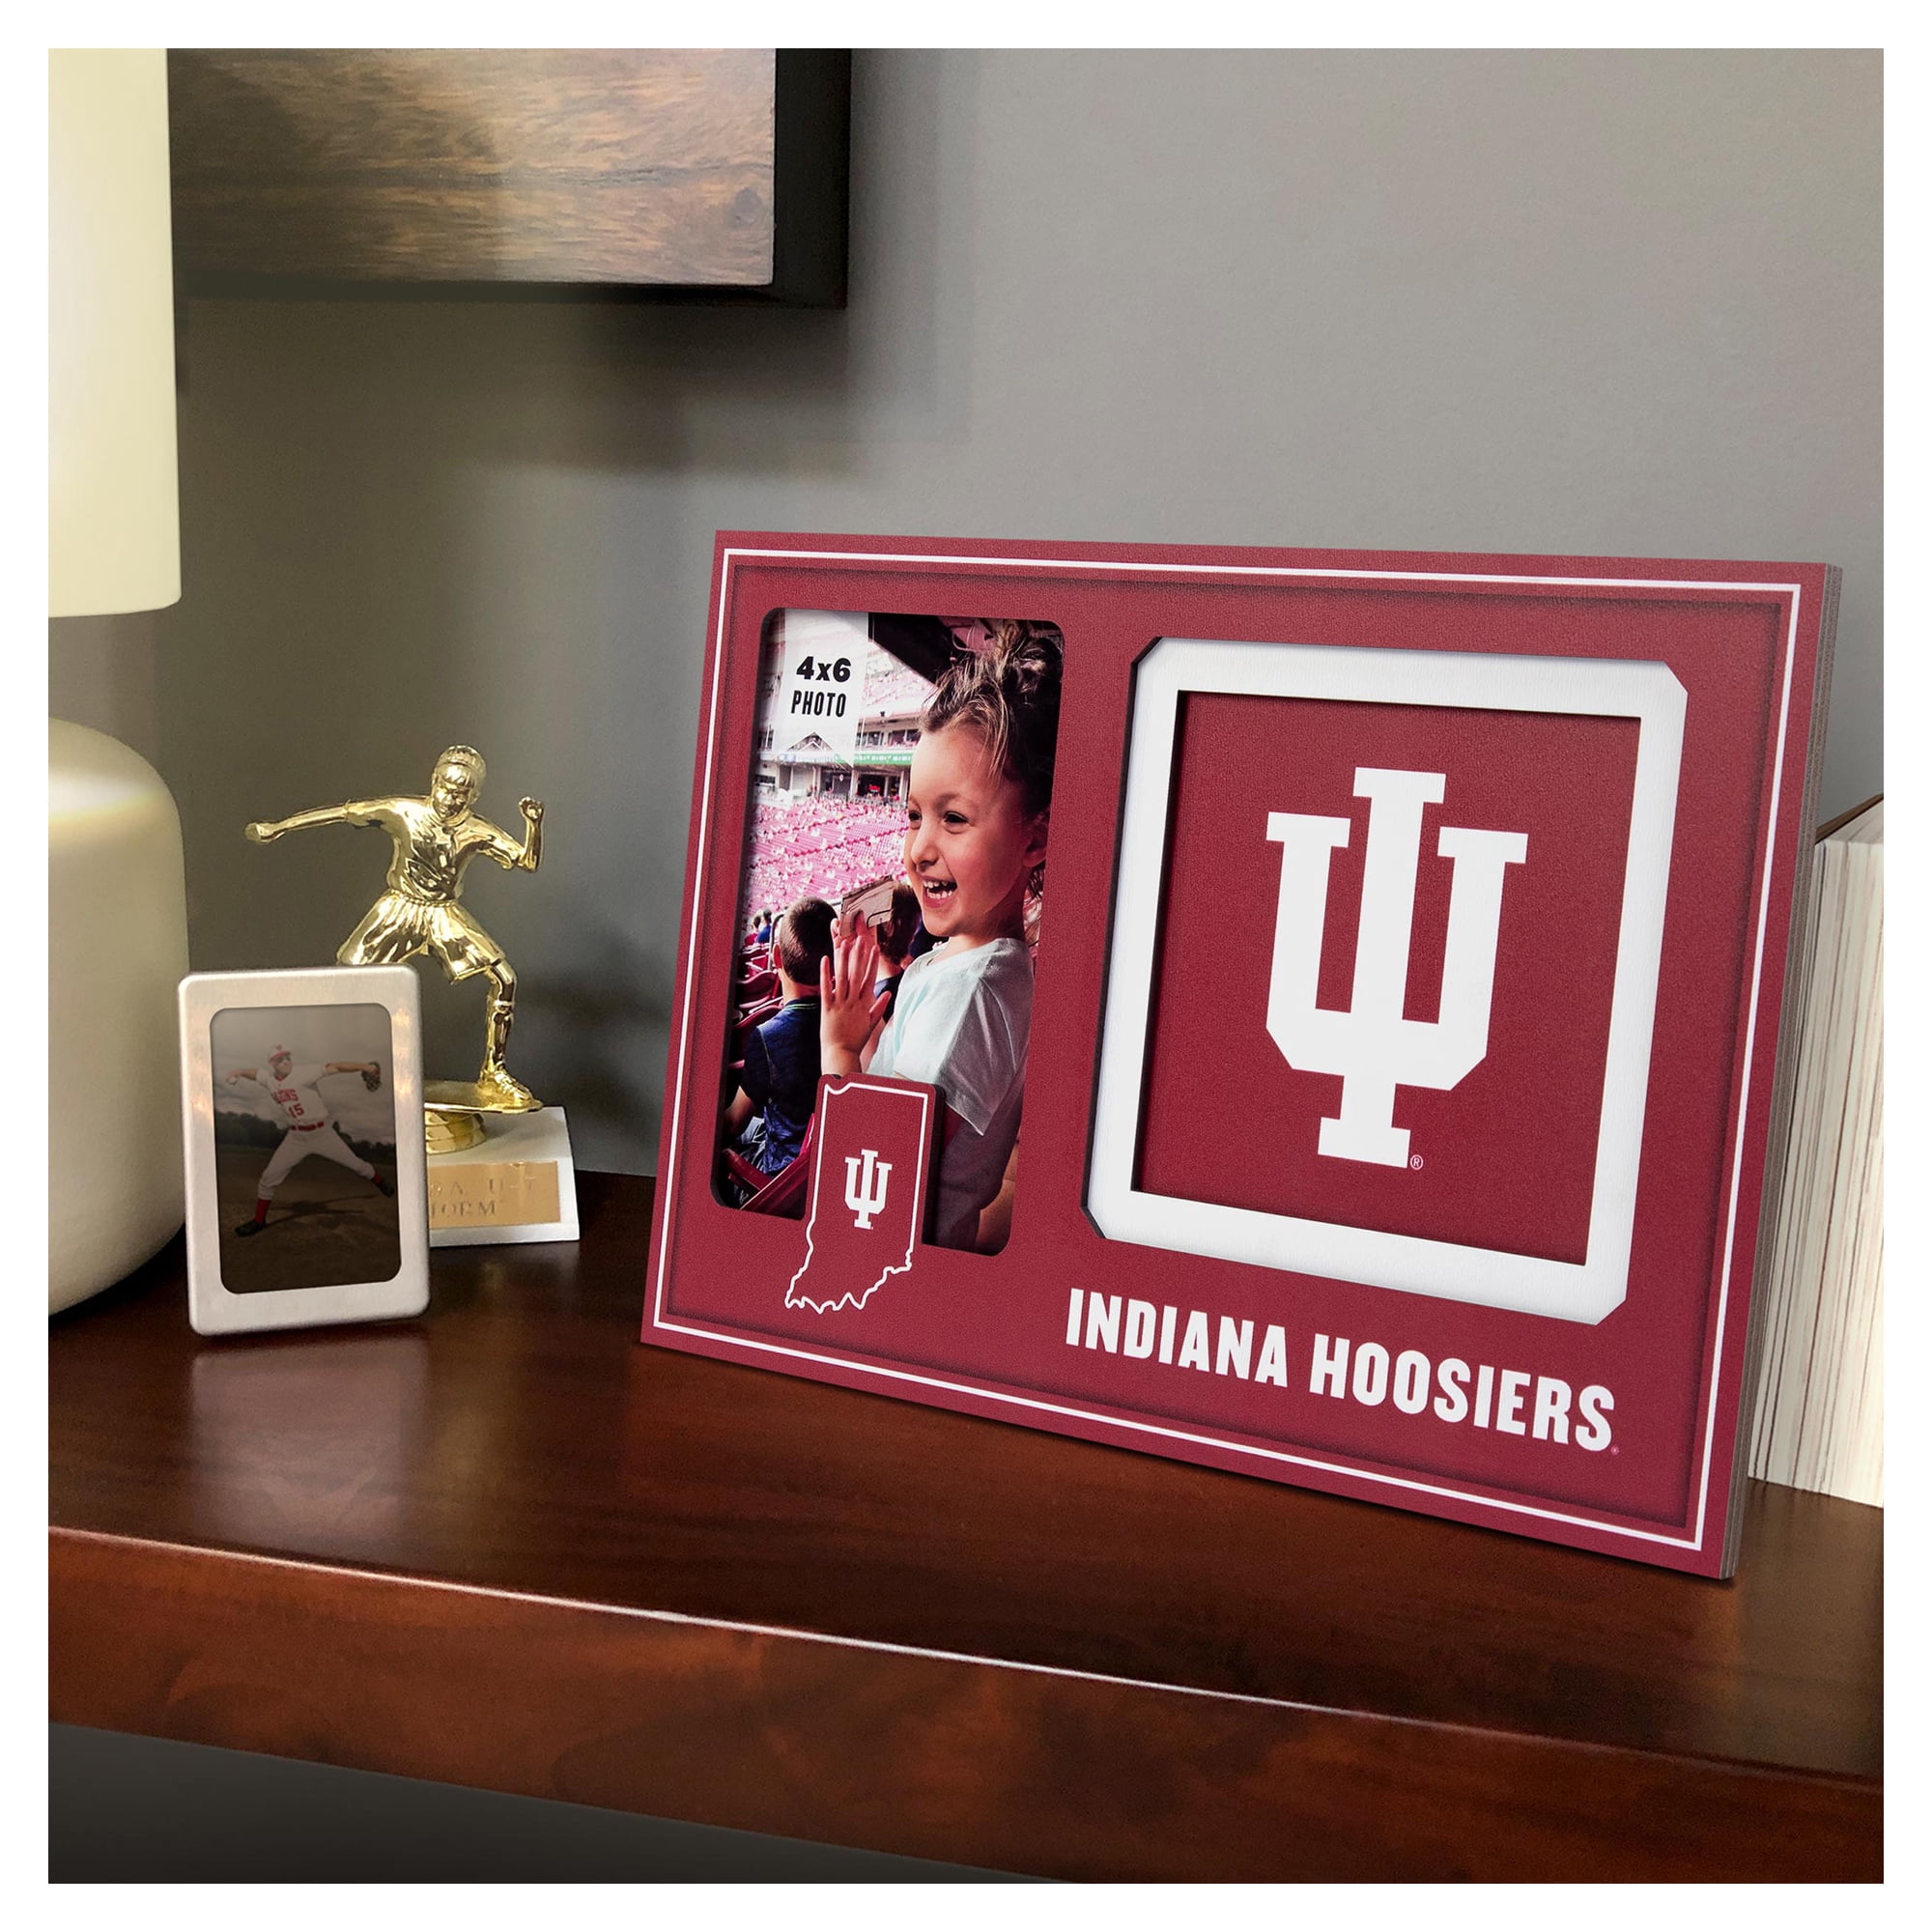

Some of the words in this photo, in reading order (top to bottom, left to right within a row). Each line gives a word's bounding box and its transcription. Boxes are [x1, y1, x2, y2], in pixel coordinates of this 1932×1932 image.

[796, 656, 852, 683] 4x6
[790, 690, 847, 718] PHOTO
[288, 1102, 305, 1119] 15
[1065, 1288, 1289, 1388] INDIANA
[1309, 1333, 1615, 1452] HOOSIERS
